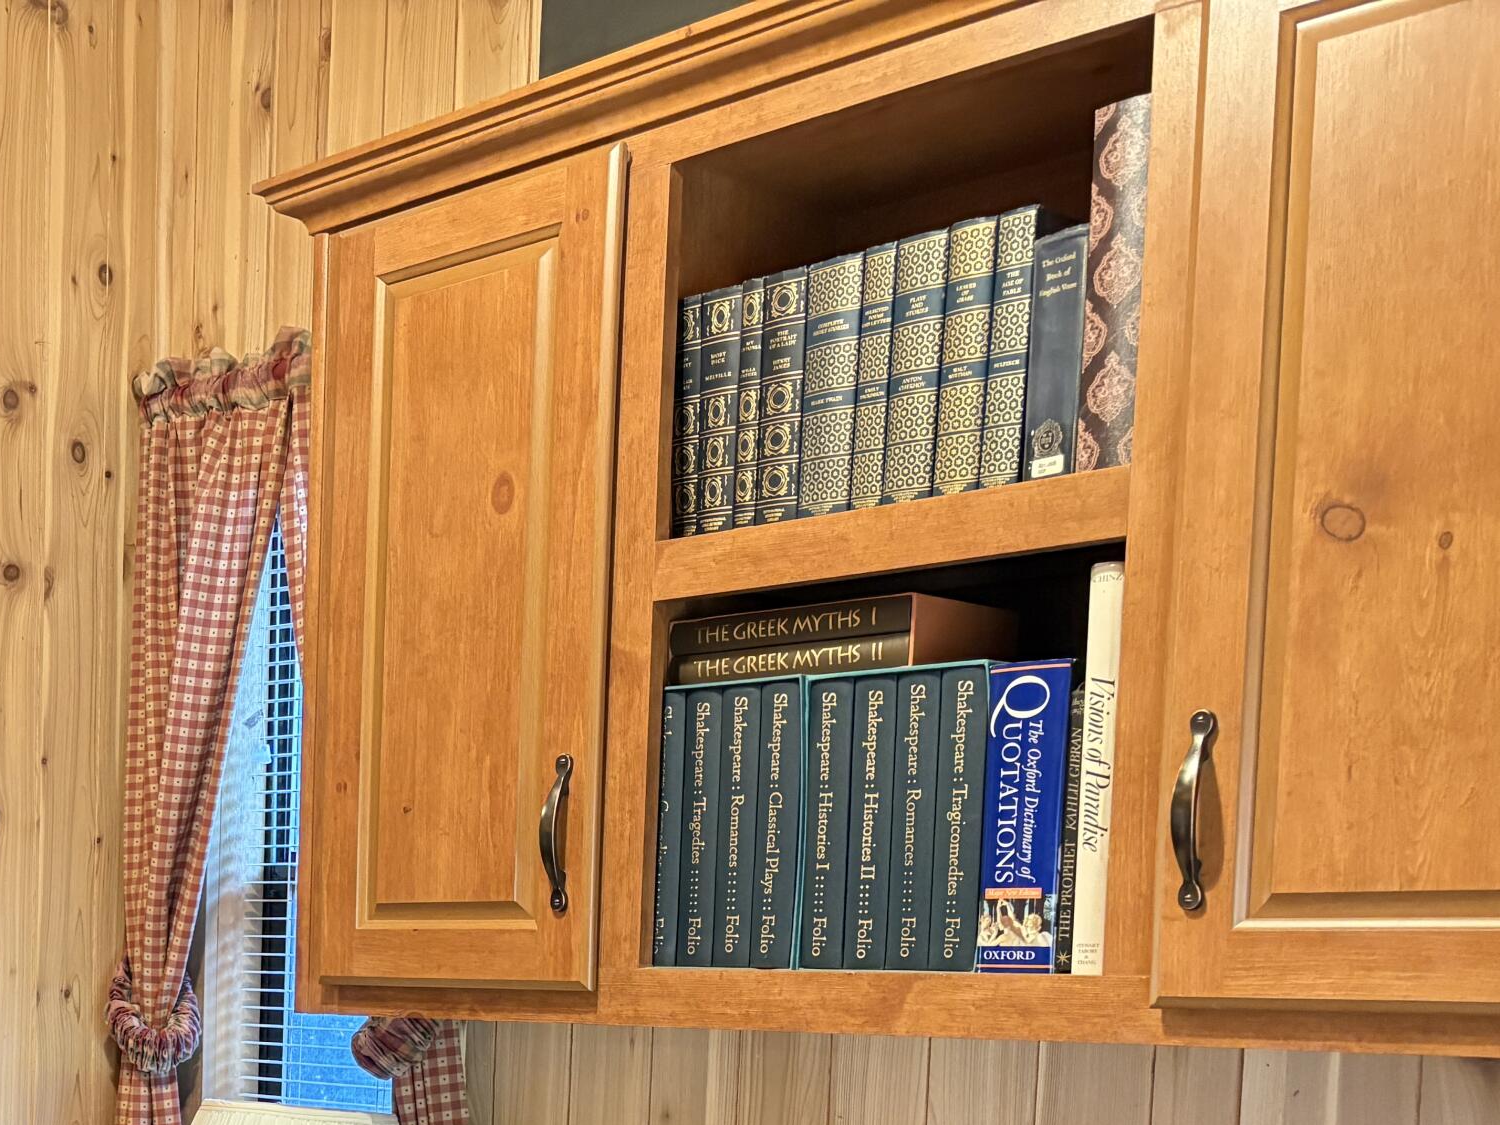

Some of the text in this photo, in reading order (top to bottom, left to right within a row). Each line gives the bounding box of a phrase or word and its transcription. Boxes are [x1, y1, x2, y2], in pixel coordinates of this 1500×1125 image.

[1006, 270, 1021, 279] THE
[1014, 278, 1024, 286] OF
[1045, 266, 1072, 282] Book of
[693, 641, 884, 678] THE GREEK MYTHS II
[694, 606, 878, 645] THE GREEK MYTHS I
[816, 691, 838, 782] Shakespeare
[990, 675, 1051, 883] QUOTATIONS
[1015, 719, 1045, 883] The Oxford Dictionary of
[1083, 677, 1116, 853] Visions of Paradise
[687, 702, 711, 956] Shakespeare Tragedies Folio
[724, 695, 749, 954] Shakespeare Romances Folio
[759, 692, 789, 954] Shakespeare Classical Plays Folio
[815, 791, 834, 860] Histories
[856, 689, 884, 959] Shakespeare Histories II Folio
[900, 683, 927, 958] Shakespeare Romances Folio
[943, 680, 974, 959] Shakespeare Tragicomedies Folio
[1059, 727, 1083, 941] THE PROPHET KAHLIL GIBRAN
[811, 916, 828, 957] Folio
[983, 950, 1036, 961] OXFORD
